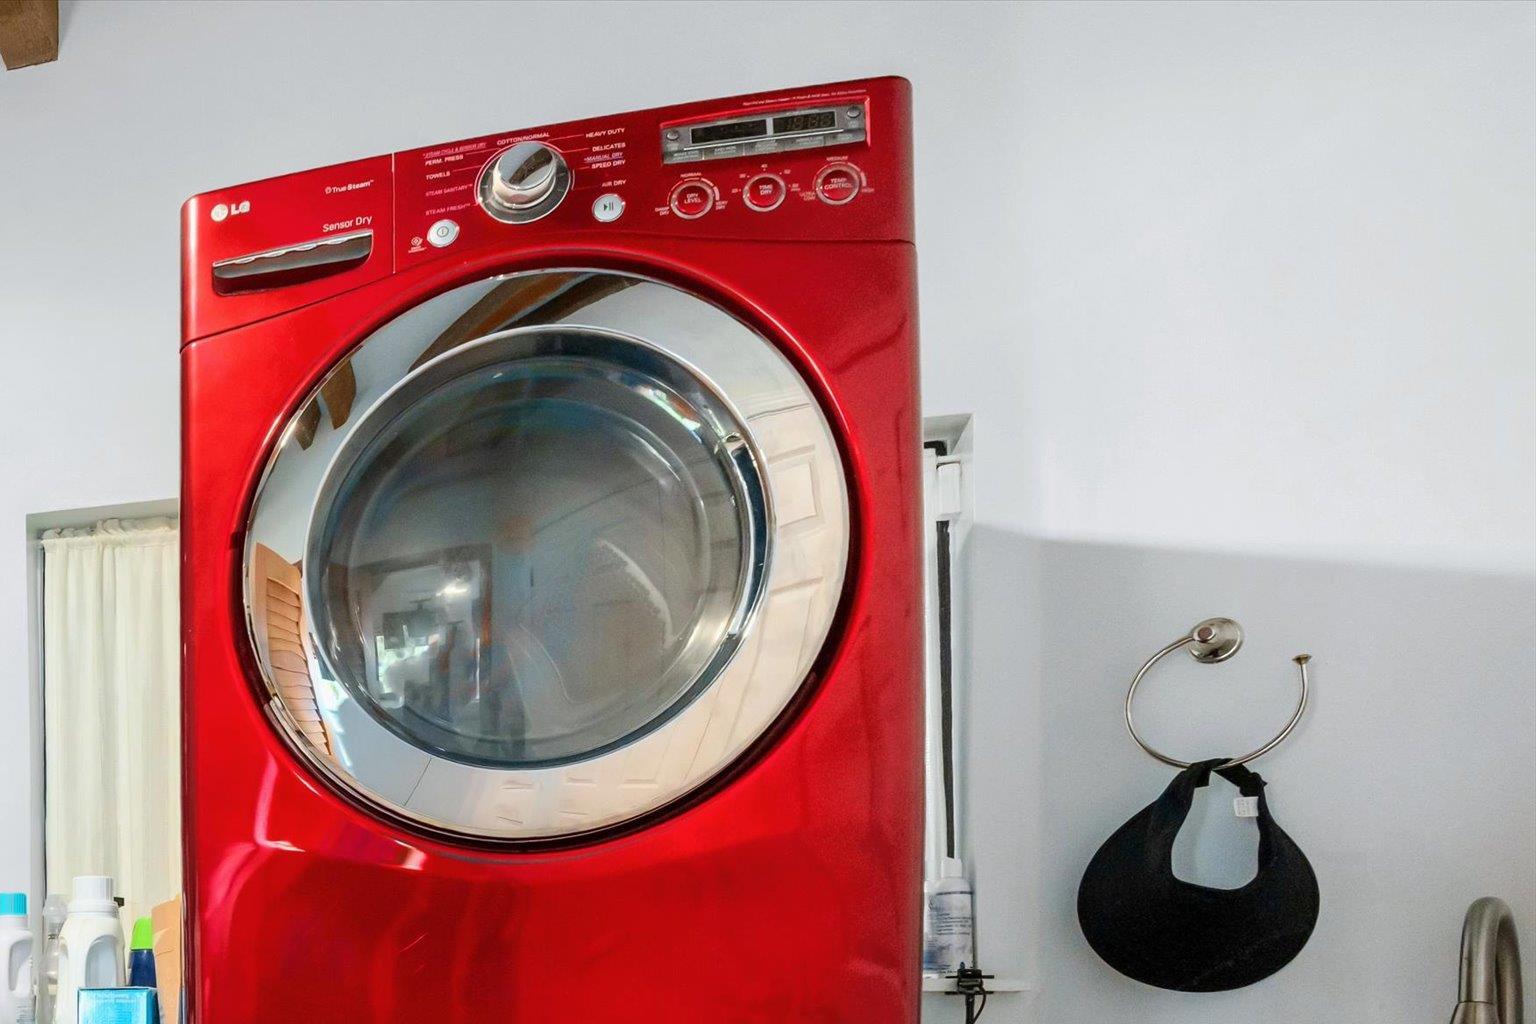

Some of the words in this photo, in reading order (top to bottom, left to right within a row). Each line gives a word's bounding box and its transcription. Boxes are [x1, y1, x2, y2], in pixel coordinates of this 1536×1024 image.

[586, 129, 606, 139] HEAVY
[607, 127, 626, 136] DUTY
[592, 142, 626, 153] DELICATES
[591, 161, 612, 170] SPEED
[612, 159, 626, 167] DRY
[425, 171, 451, 181] TOWELS
[601, 180, 613, 188] AIR
[613, 179, 627, 187] DRY
[230, 200, 251, 216] LG
[322, 219, 353, 234] Sensor
[355, 215, 373, 228] Dry
